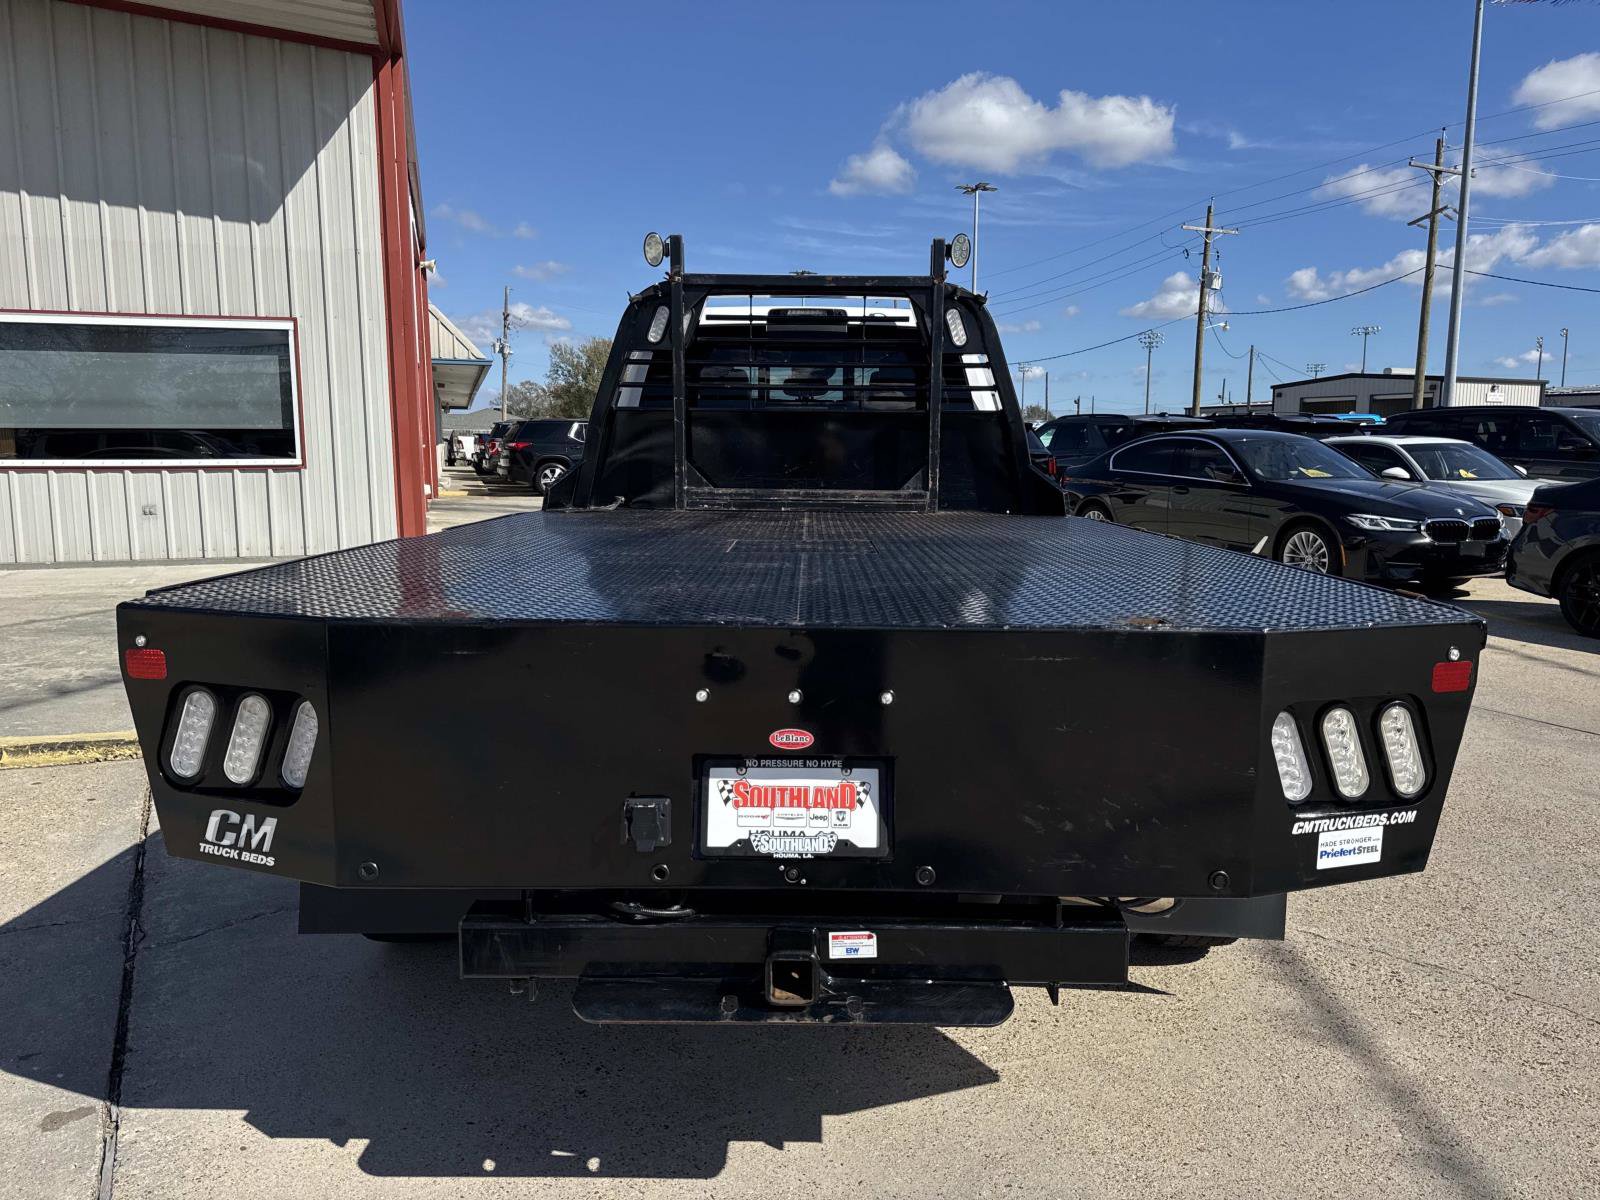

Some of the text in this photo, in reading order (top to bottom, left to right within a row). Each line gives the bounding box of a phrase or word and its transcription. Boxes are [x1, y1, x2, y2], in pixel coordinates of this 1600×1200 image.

[775, 734, 809, 742] LeBlanc
[746, 759, 843, 767] NO PRESSURE NO HYPE
[732, 780, 857, 811] SOUTHLAND
[809, 814, 828, 822] Jeep
[1292, 810, 1417, 835] CMTRUCKBEDS.COM
[205, 809, 277, 852] CM
[760, 834, 829, 853] SOUTHLAND
[1339, 837, 1372, 846] STRONGER
[199, 842, 275, 866] TRUCK BEDS
